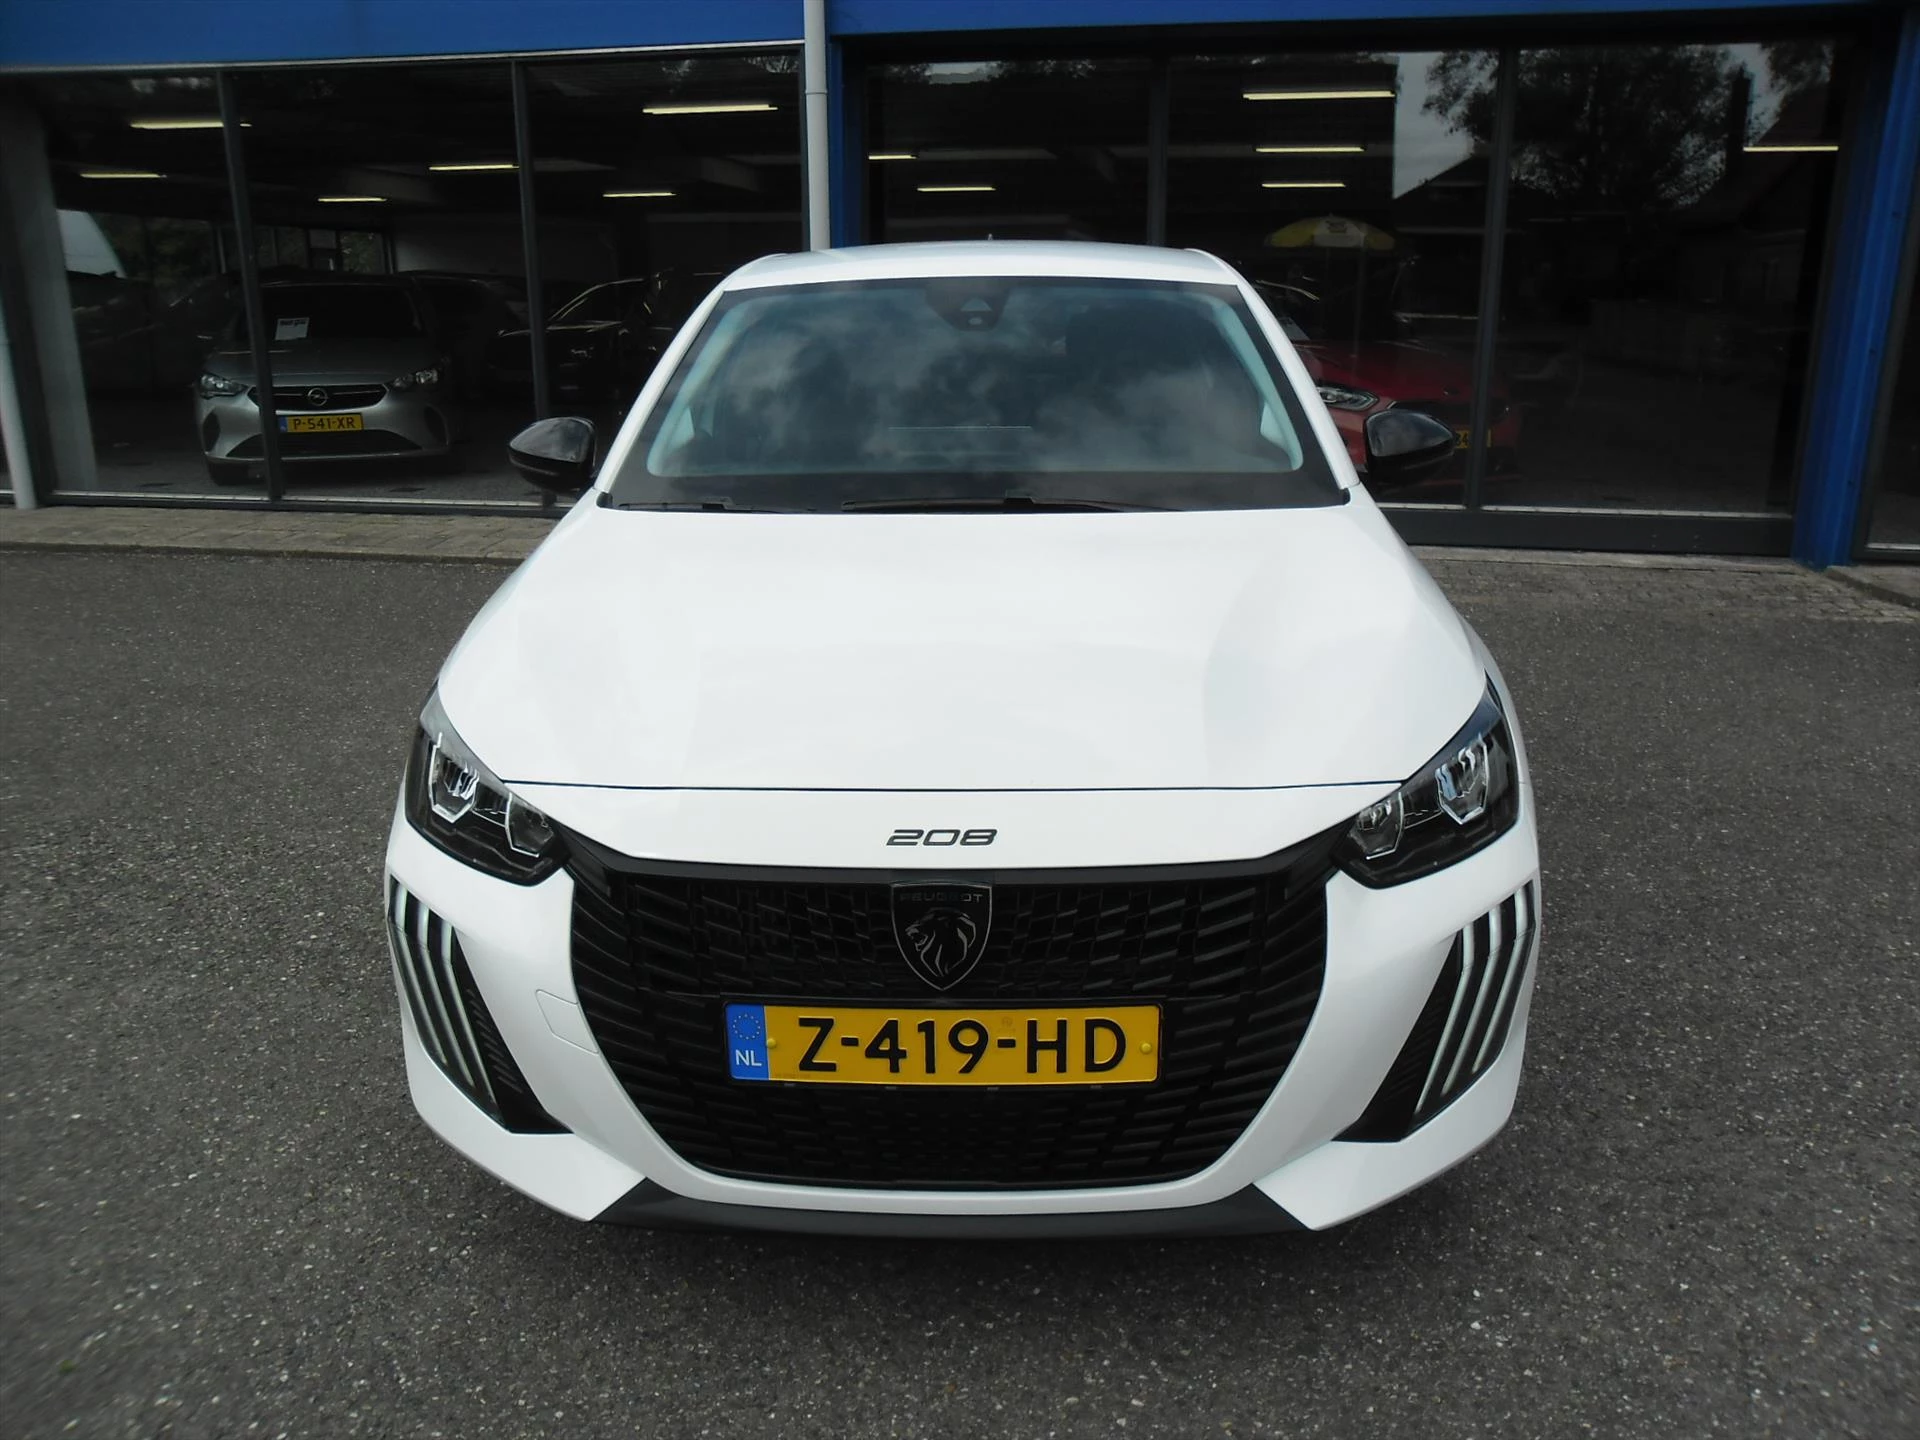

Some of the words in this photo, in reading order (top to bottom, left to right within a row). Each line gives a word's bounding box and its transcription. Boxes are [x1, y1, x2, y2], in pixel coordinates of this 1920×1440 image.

[293, 416, 356, 430] P-541-XR
[886, 829, 998, 846] 208
[798, 1016, 1127, 1074] Z-419-HD
[734, 1048, 763, 1067] NL
